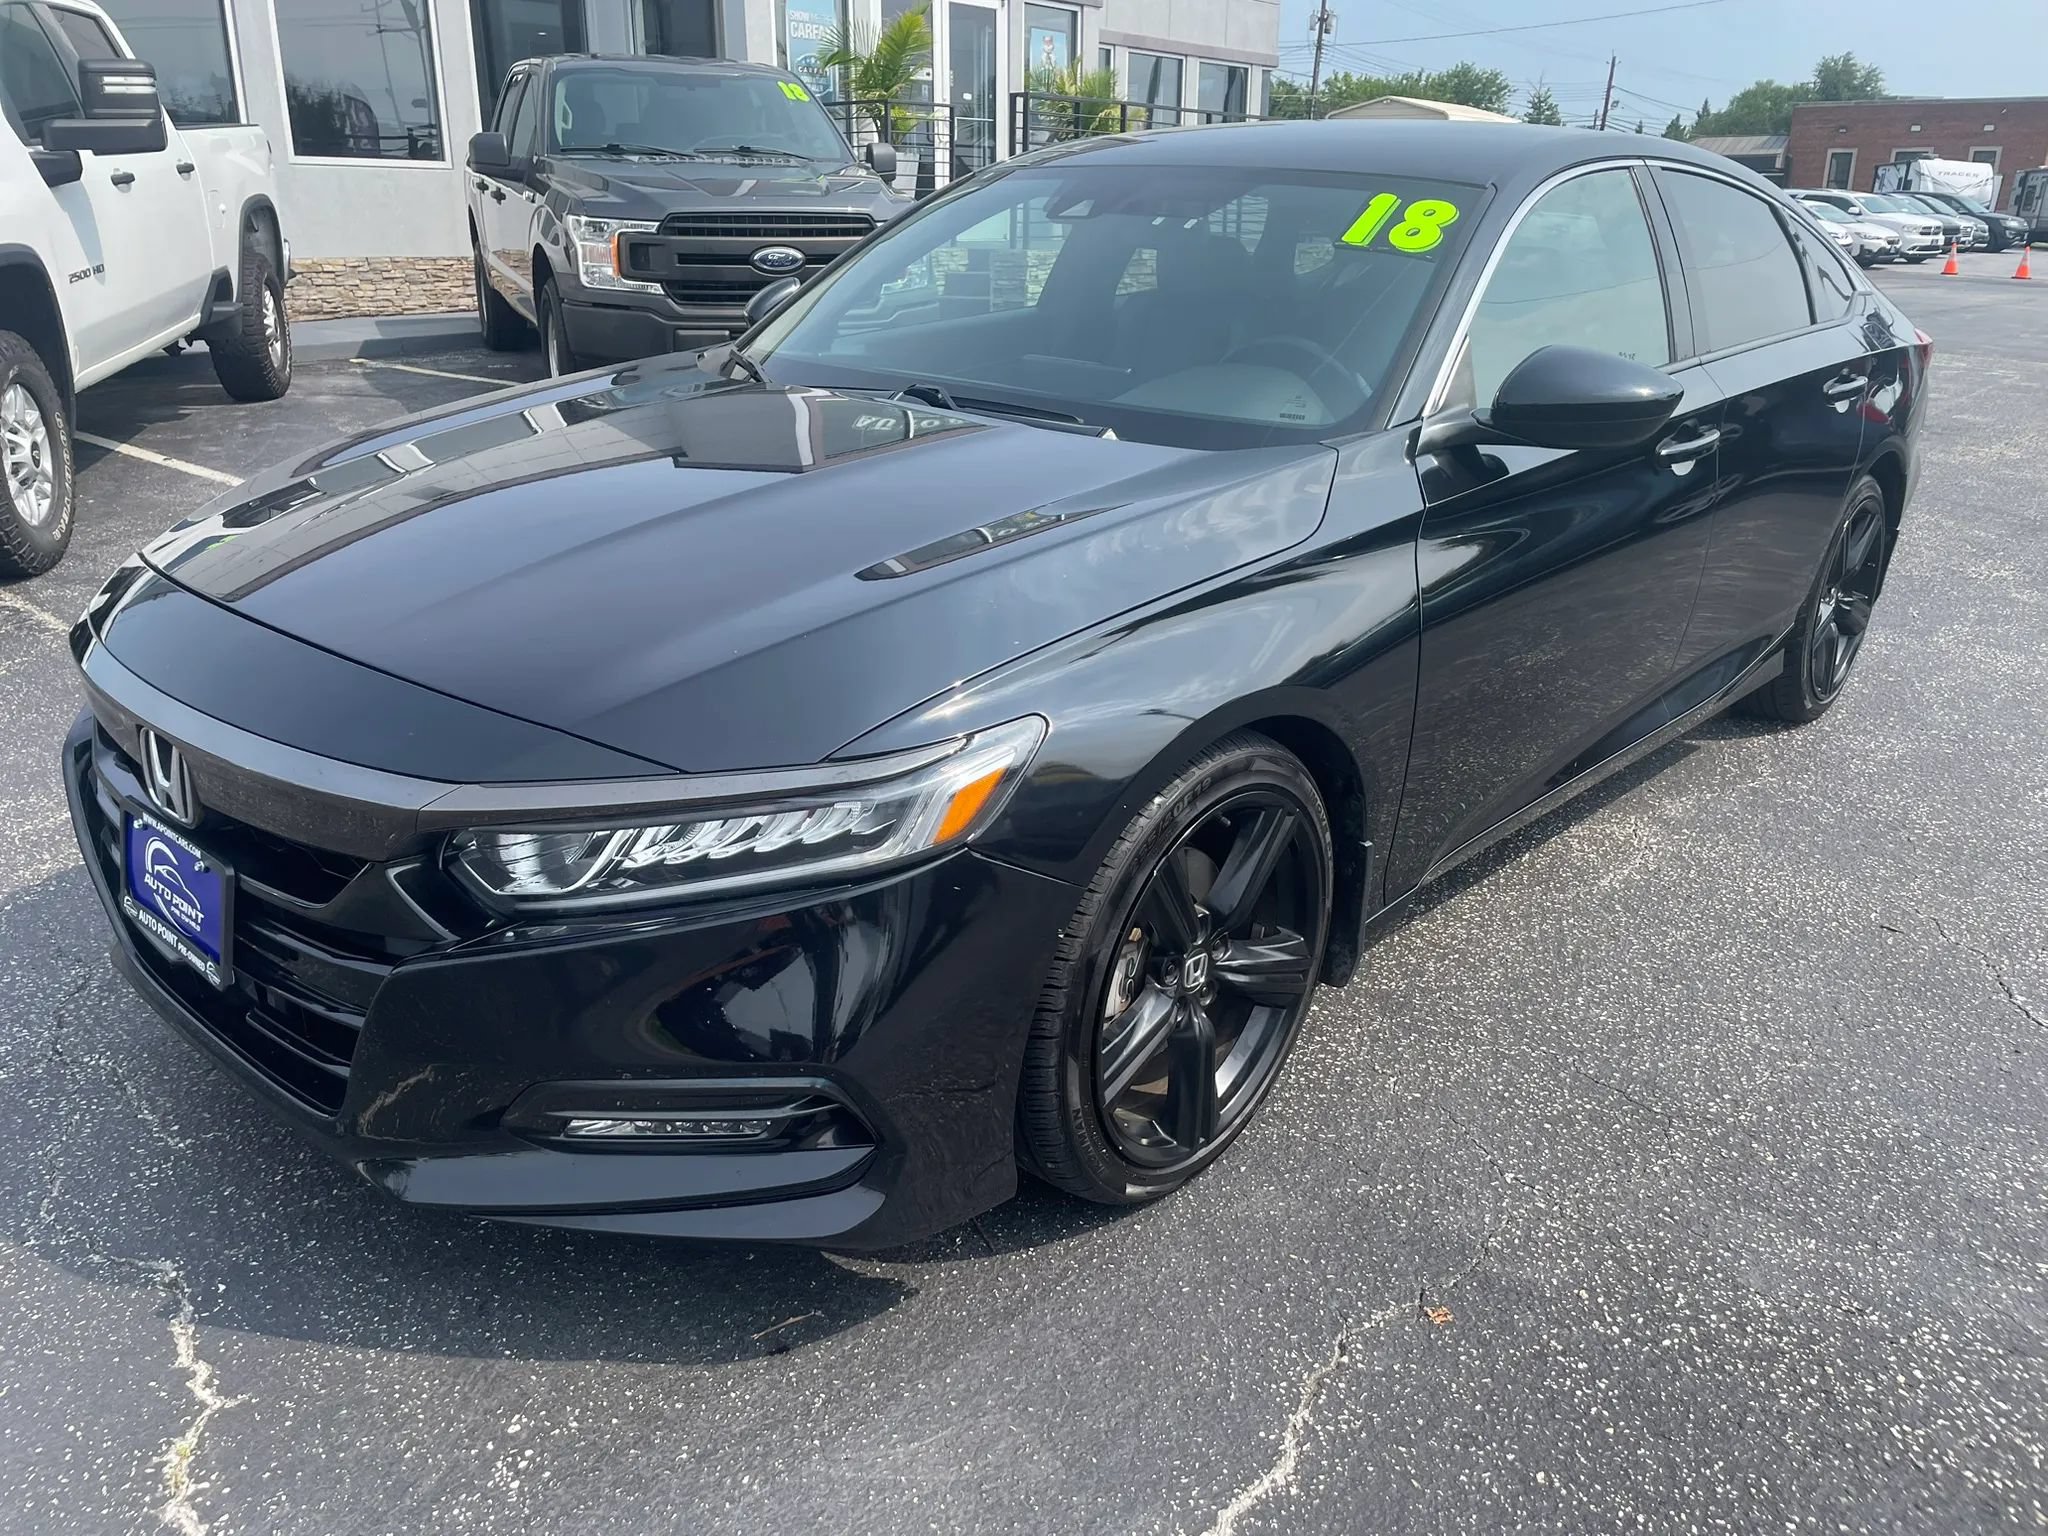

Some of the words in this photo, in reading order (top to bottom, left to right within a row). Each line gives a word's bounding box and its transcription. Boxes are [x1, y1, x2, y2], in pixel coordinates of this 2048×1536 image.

[1937, 170, 1980, 178] TRACER
[1341, 192, 1460, 253] 18
[68, 268, 92, 284] 2500
[92, 263, 105, 275] HD
[144, 872, 172, 901] AUTO
[172, 892, 205, 924] POINT
[138, 909, 157, 932] AUTO
[157, 922, 178, 948] POINT
[177, 942, 206, 972] PRE-OWNED
